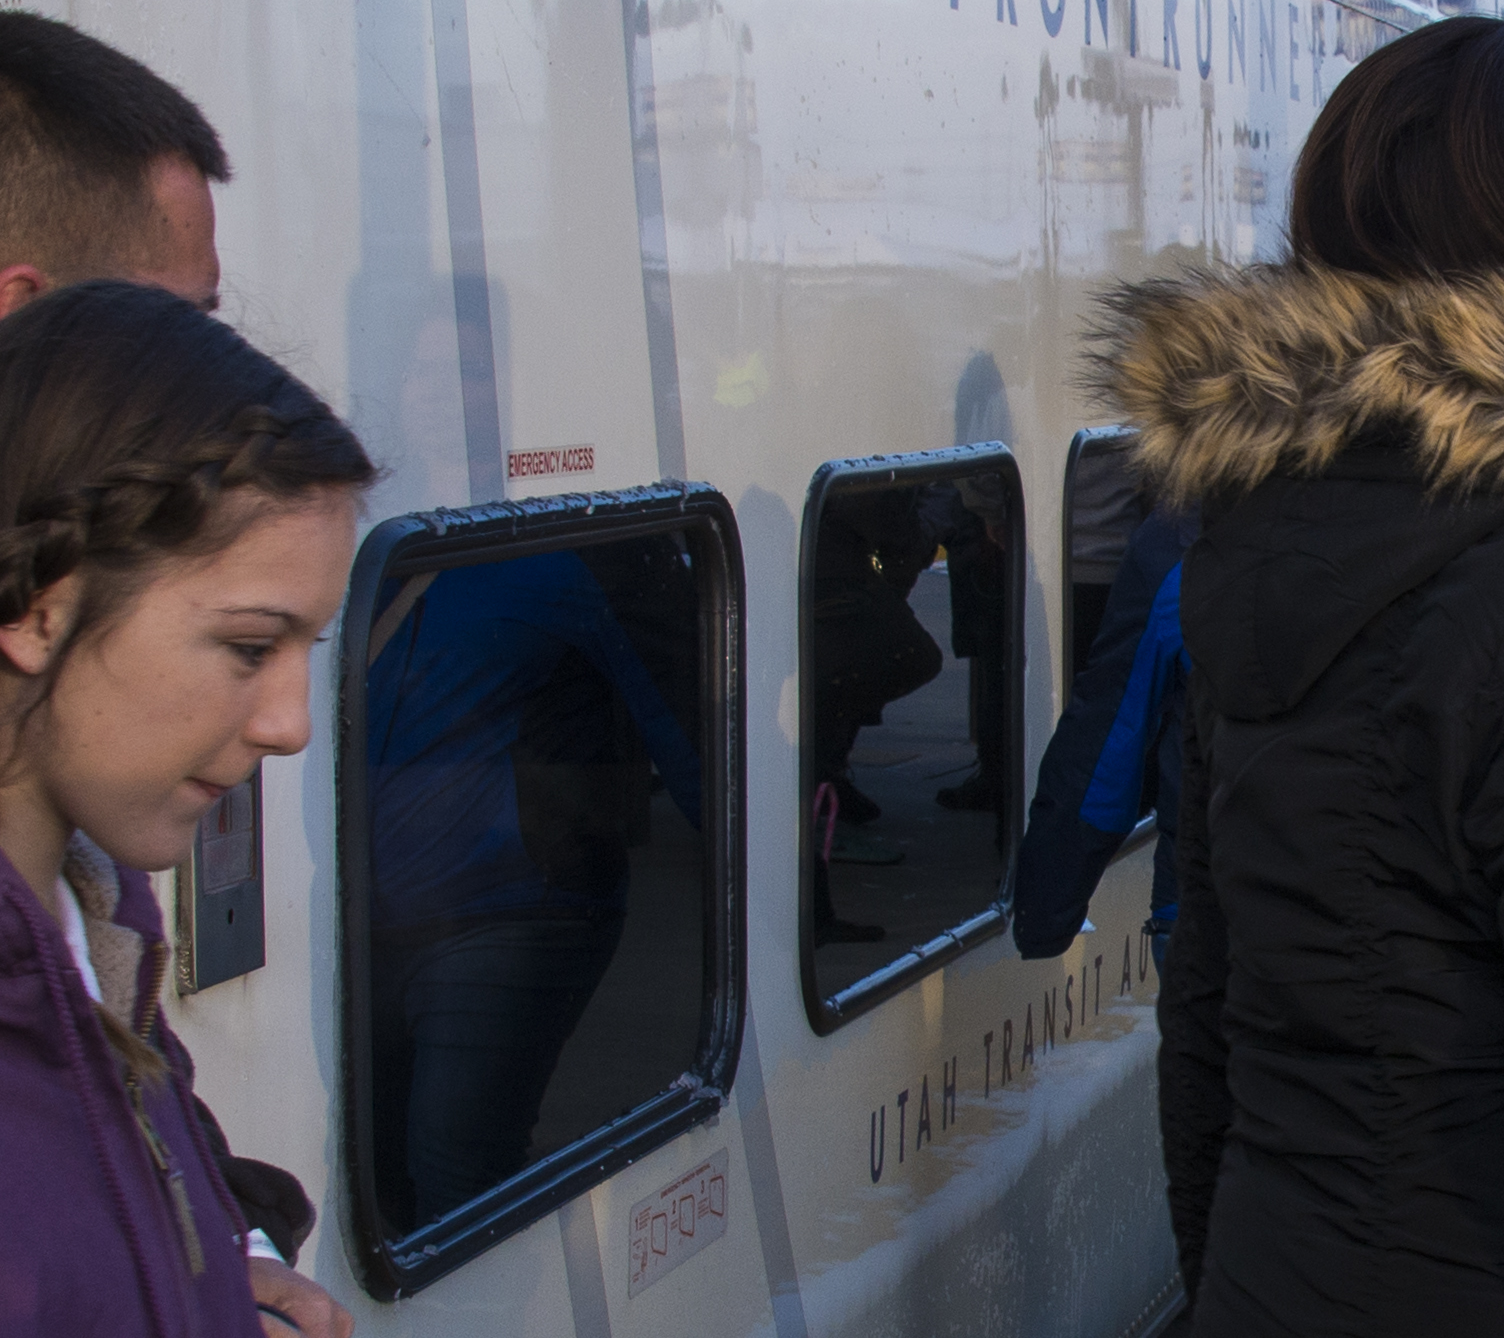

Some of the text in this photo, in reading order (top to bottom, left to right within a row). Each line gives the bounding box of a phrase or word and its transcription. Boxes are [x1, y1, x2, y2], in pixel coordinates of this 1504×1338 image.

[508, 446, 594, 477] EMERGENCY ACCESS
[870, 1055, 957, 1184] UTAH
[984, 954, 1103, 1101] TRANSIT
